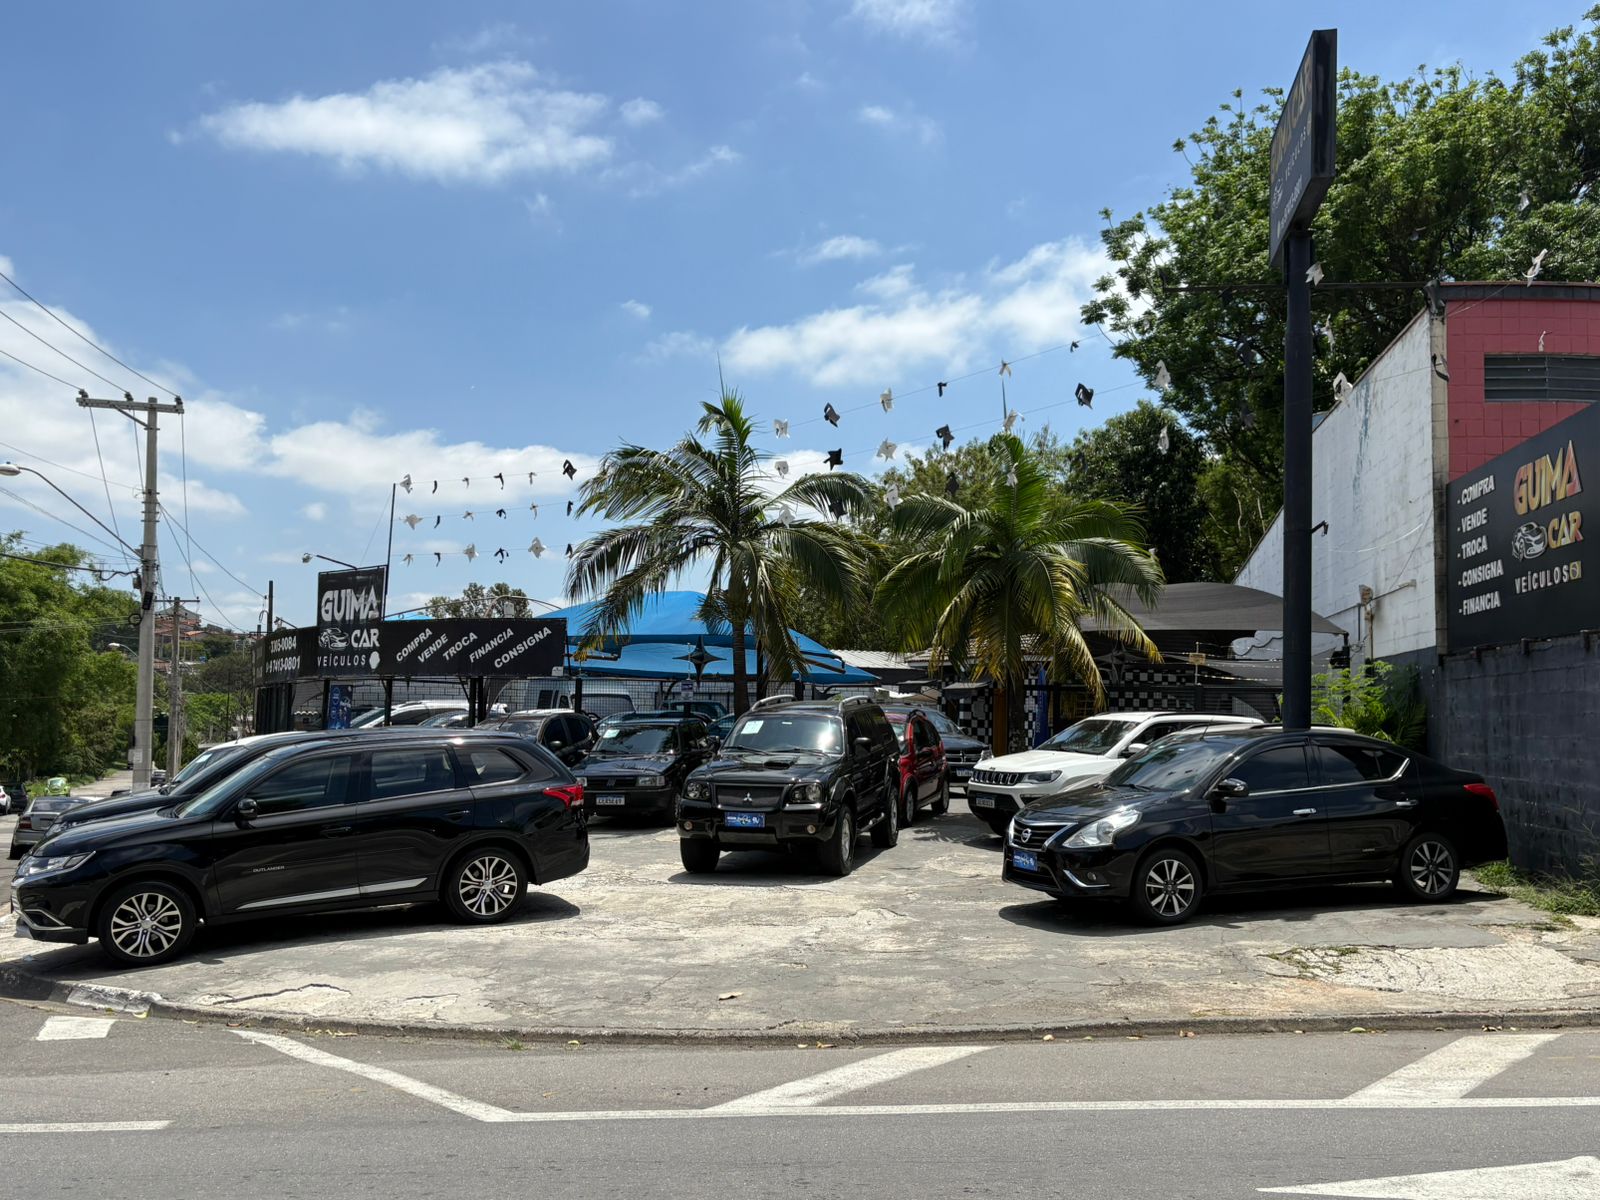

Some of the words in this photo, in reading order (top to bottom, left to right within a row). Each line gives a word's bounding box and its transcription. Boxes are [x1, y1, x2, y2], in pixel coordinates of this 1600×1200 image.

[1461, 475, 1495, 505] COMPRA
[1514, 440, 1582, 515] GUIMA
[1461, 507, 1488, 533] VENDE
[1548, 511, 1584, 549] CAR
[1461, 535, 1488, 560] TROCA
[1462, 559, 1504, 588] CONSIGNA
[1515, 564, 1570, 594] VEÍCULOS
[321, 585, 380, 621] GUIMA
[1463, 591, 1501, 616] FINANCIA
[351, 628, 381, 648] CAR
[396, 628, 433, 662] COMPRA
[417, 633, 449, 663] VENDE
[442, 632, 478, 661] TROCA
[469, 628, 514, 663] FINANCIA
[494, 626, 552, 668] CONSIGNA
[317, 653, 367, 667] VEÍCULOS
